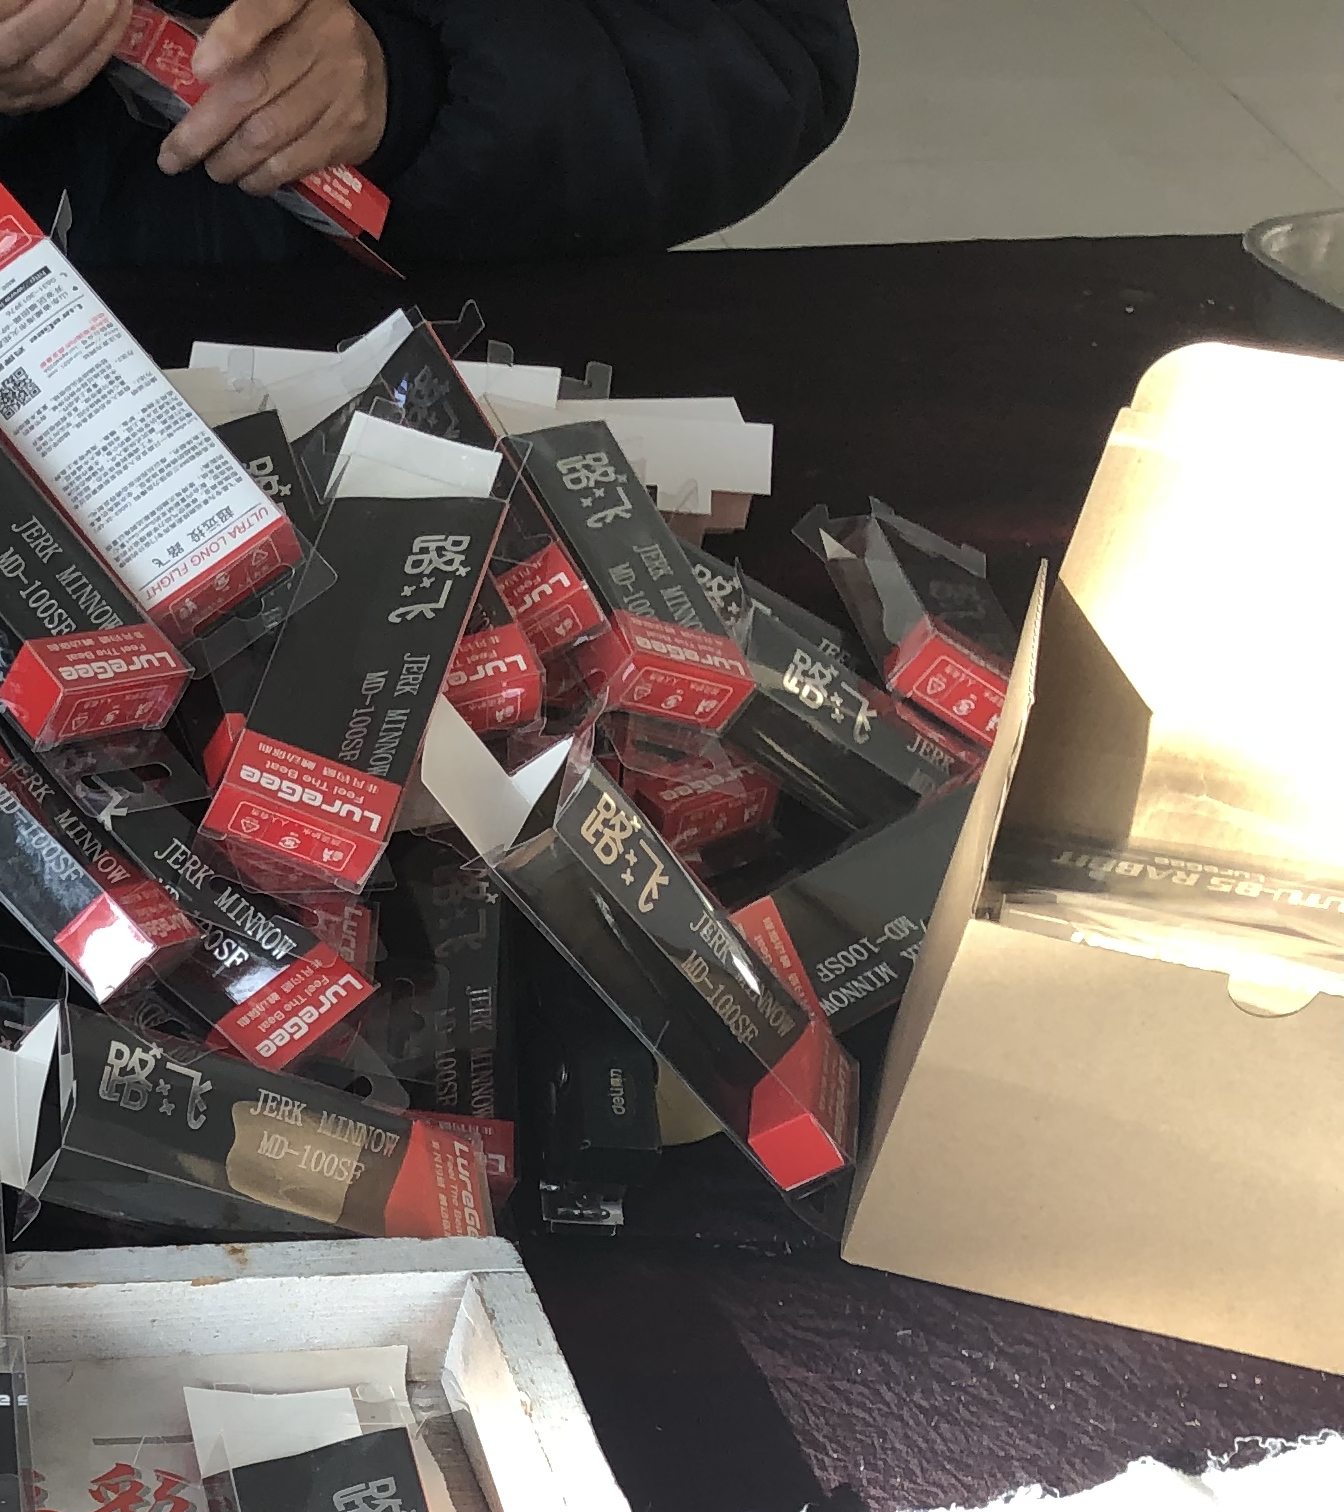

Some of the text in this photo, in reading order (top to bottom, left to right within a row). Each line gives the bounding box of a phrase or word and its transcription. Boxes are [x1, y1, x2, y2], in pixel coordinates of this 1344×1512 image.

[11, 515, 124, 630] JERK MINNOW
[59, 651, 176, 680] LureGee
[635, 636, 745, 676] LureGee
[338, 669, 389, 762] MD-100SF
[367, 652, 431, 777] JERK MINNOW
[240, 765, 382, 832] LureGee
[54, 809, 132, 884] MINNOW
[154, 839, 297, 960] JERK MINNOW
[817, 916, 915, 980] MD-100SF
[255, 973, 363, 1058] LureGee
[821, 962, 898, 1018] MINNOW
[249, 1088, 399, 1158] JERK MINNOW
[257, 1131, 365, 1183] MD-100SF
